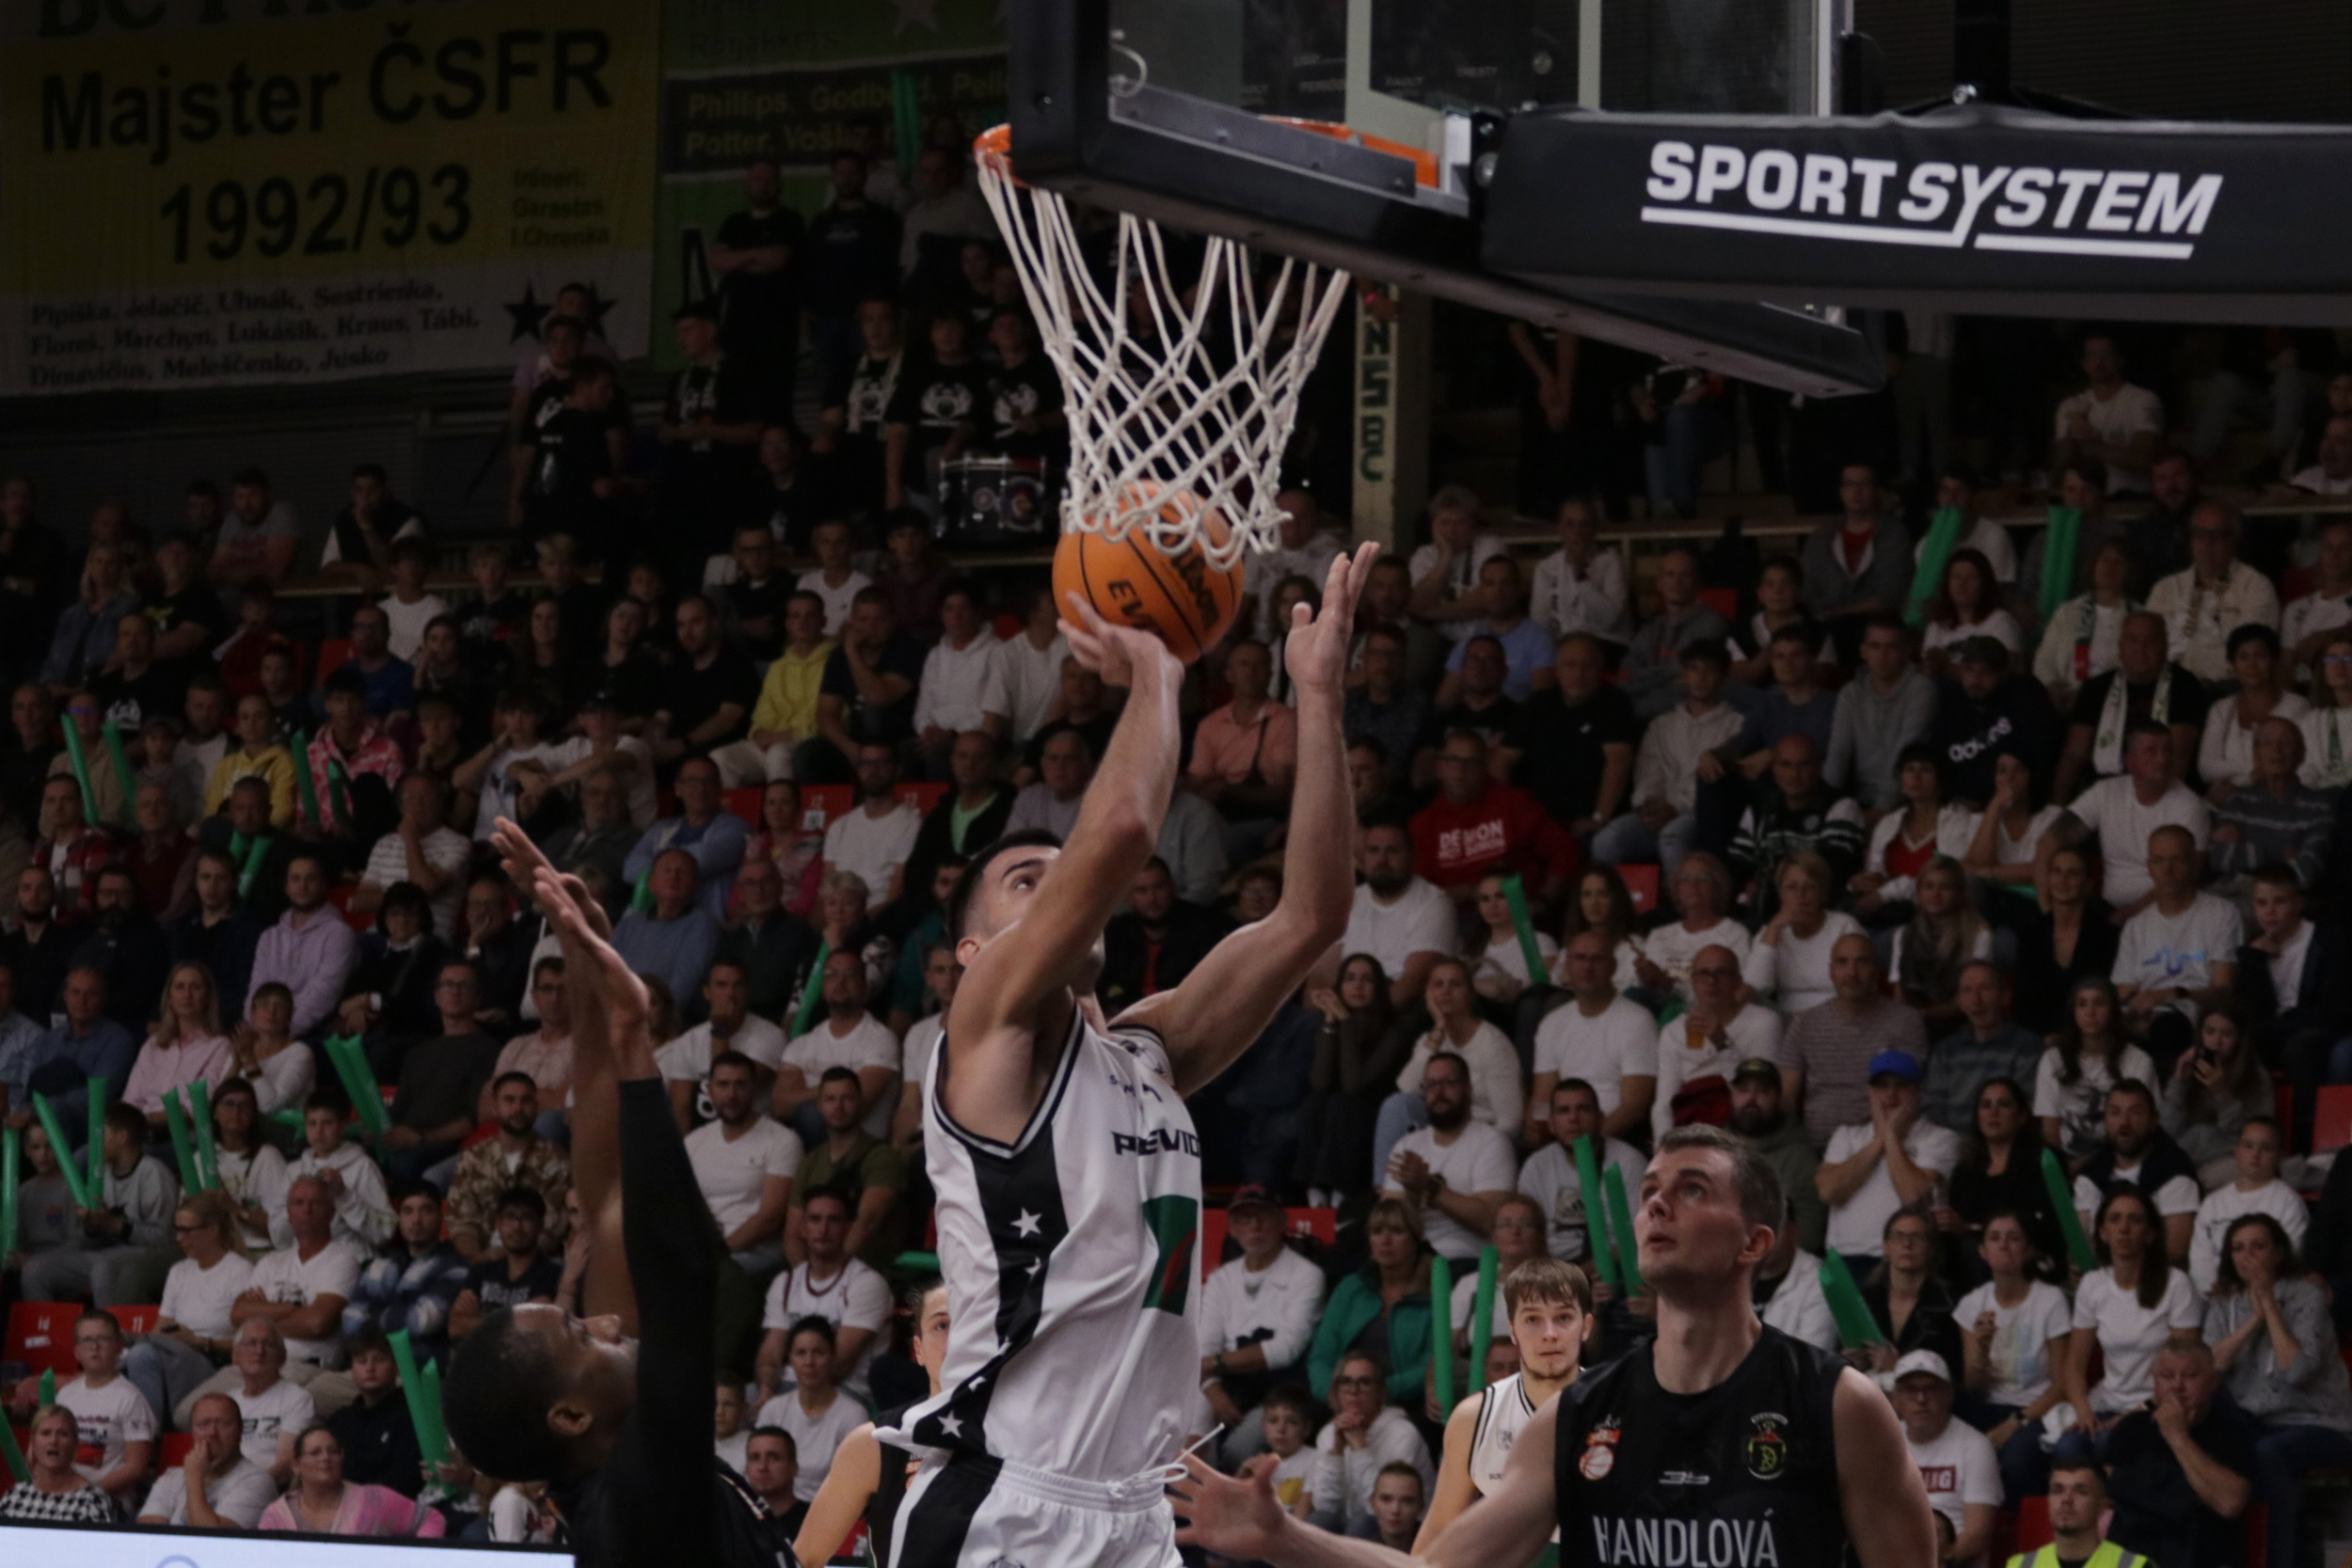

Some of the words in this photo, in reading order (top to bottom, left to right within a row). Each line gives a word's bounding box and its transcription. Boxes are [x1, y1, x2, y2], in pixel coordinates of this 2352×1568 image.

[42, 59, 340, 165] Majster
[369, 20, 612, 125] ČSFR
[160, 164, 470, 263] 1992/93
[1645, 140, 1897, 218] SPORT
[1899, 163, 2223, 246] SYSTEM
[1592, 1508, 1779, 1568] HANDLOVÁ
